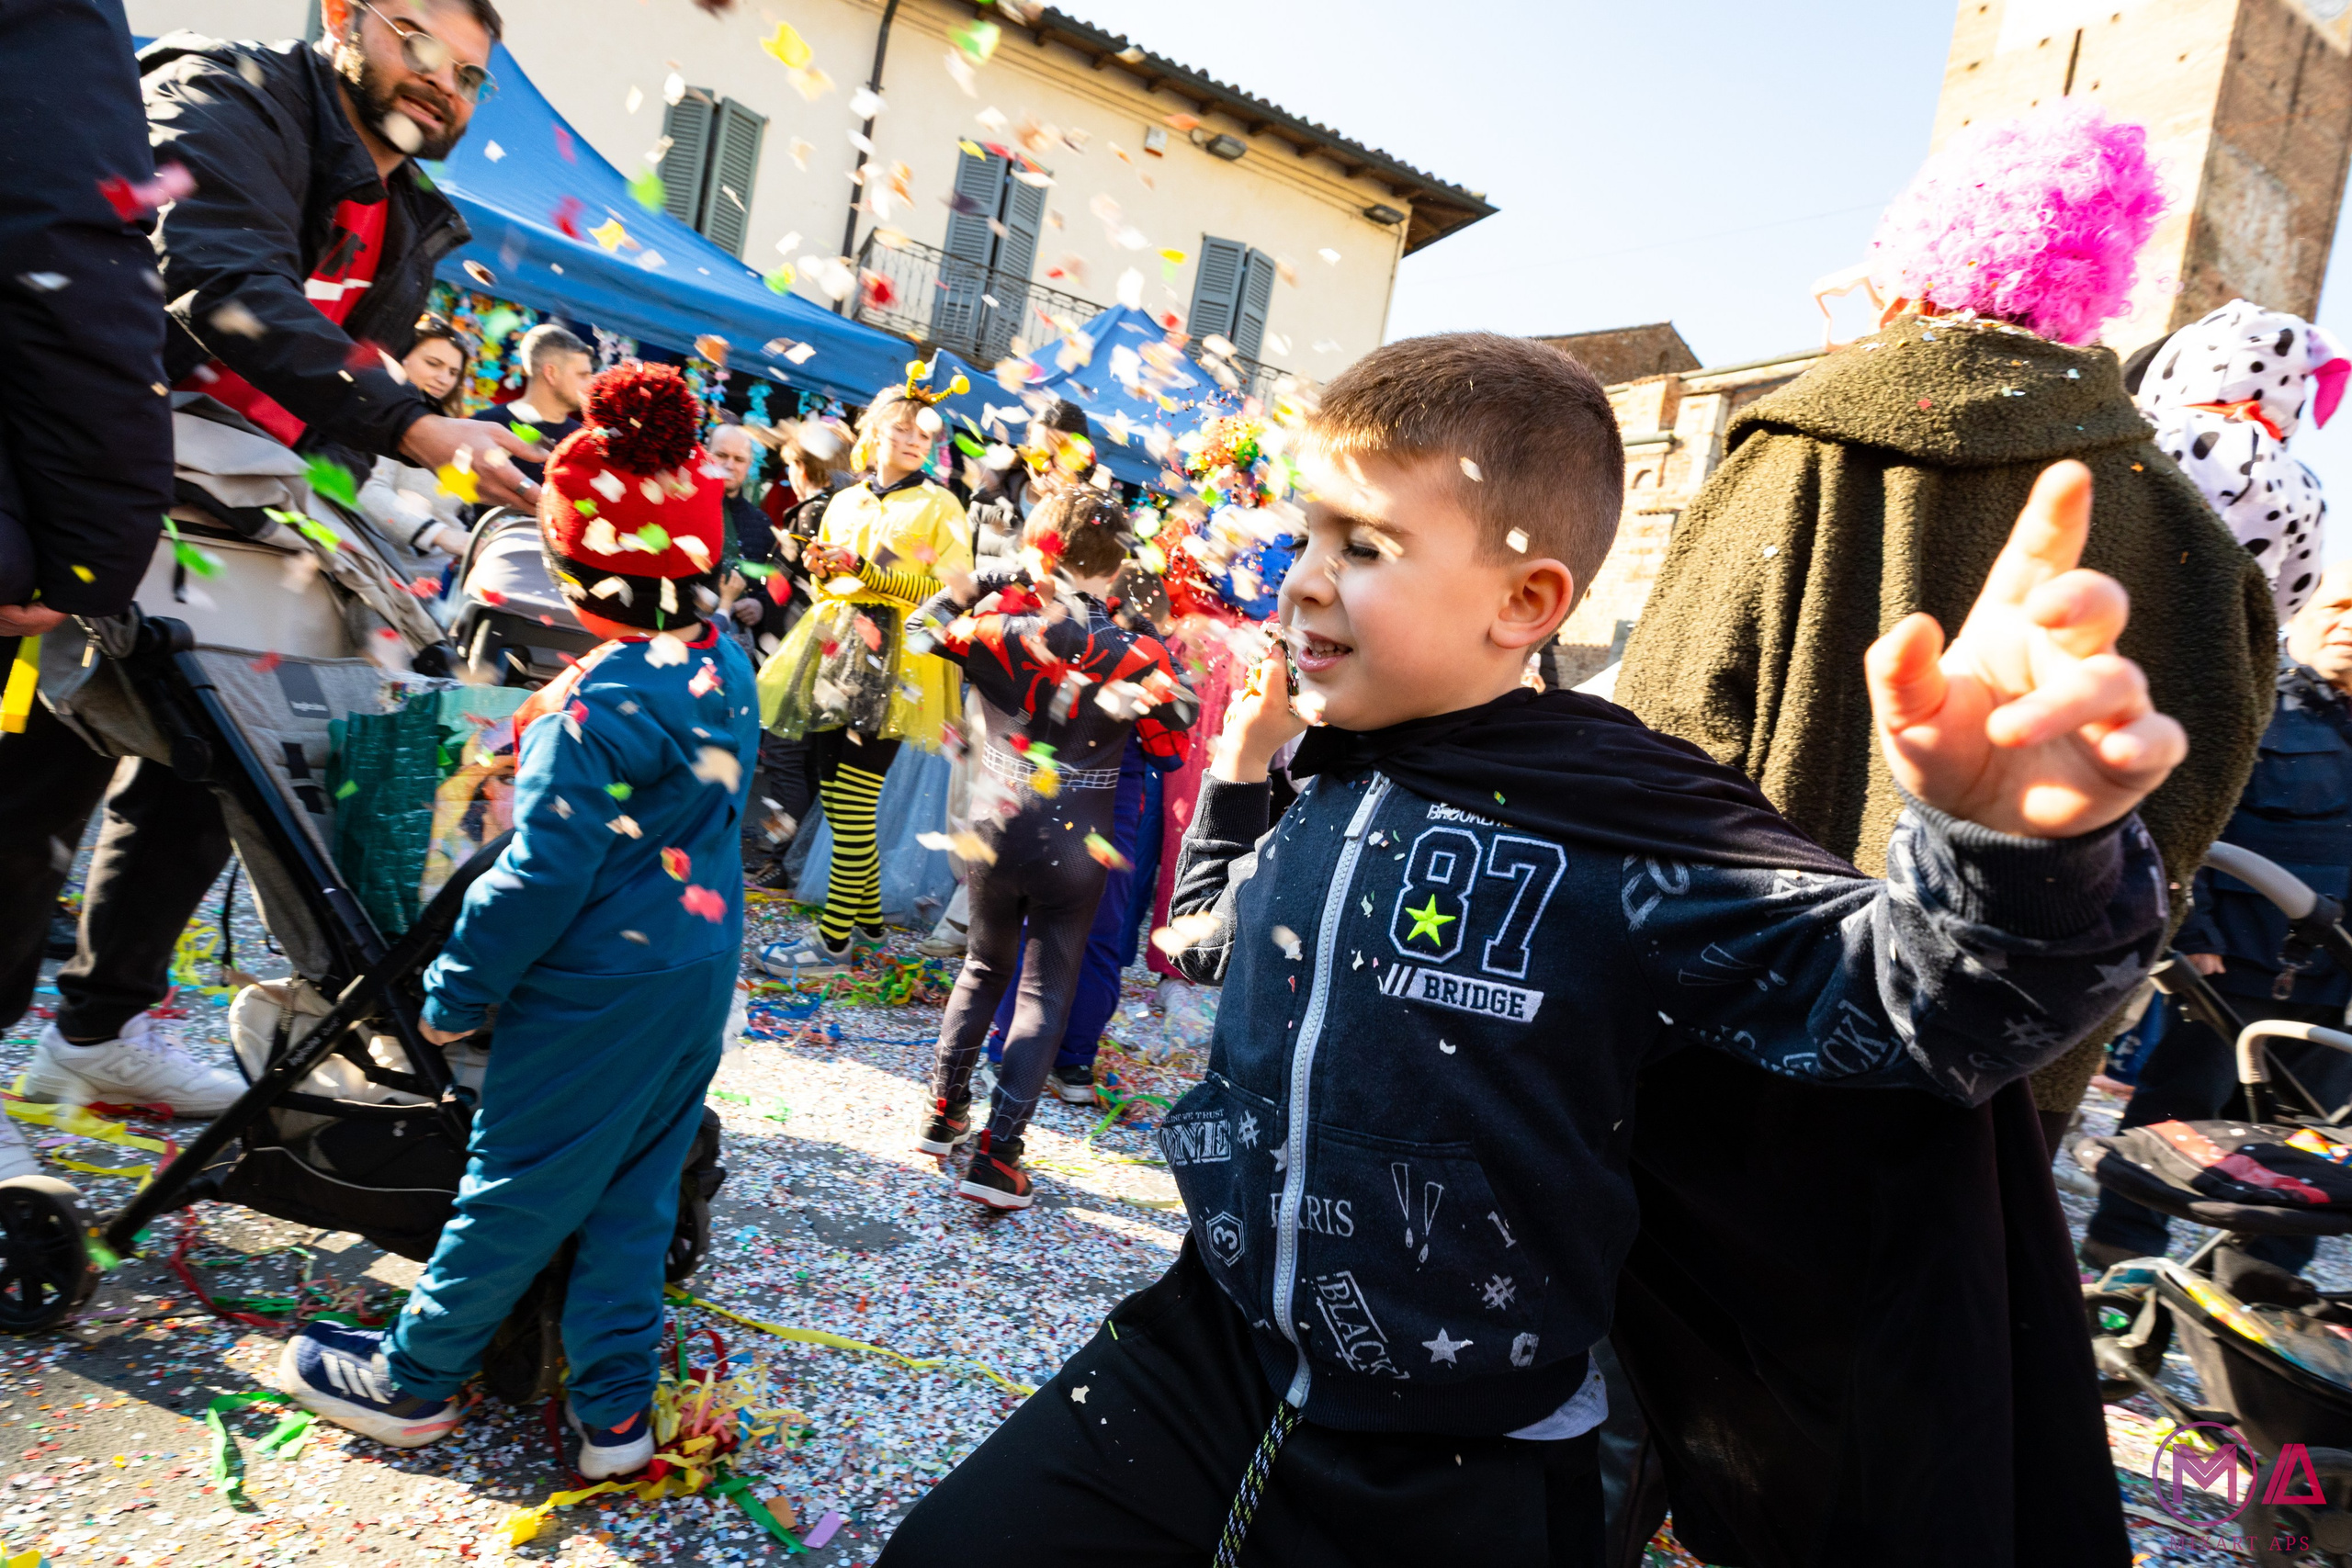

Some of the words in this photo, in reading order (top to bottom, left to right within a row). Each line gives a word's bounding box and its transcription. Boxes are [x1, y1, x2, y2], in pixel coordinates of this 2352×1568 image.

[1388, 826, 1568, 980] 87
[1421, 975, 1527, 1019] BRIDGE
[1194, 1108, 1225, 1120] TRUST
[1213, 1225, 1238, 1250] 3
[1319, 1280, 1400, 1379] BLACK
